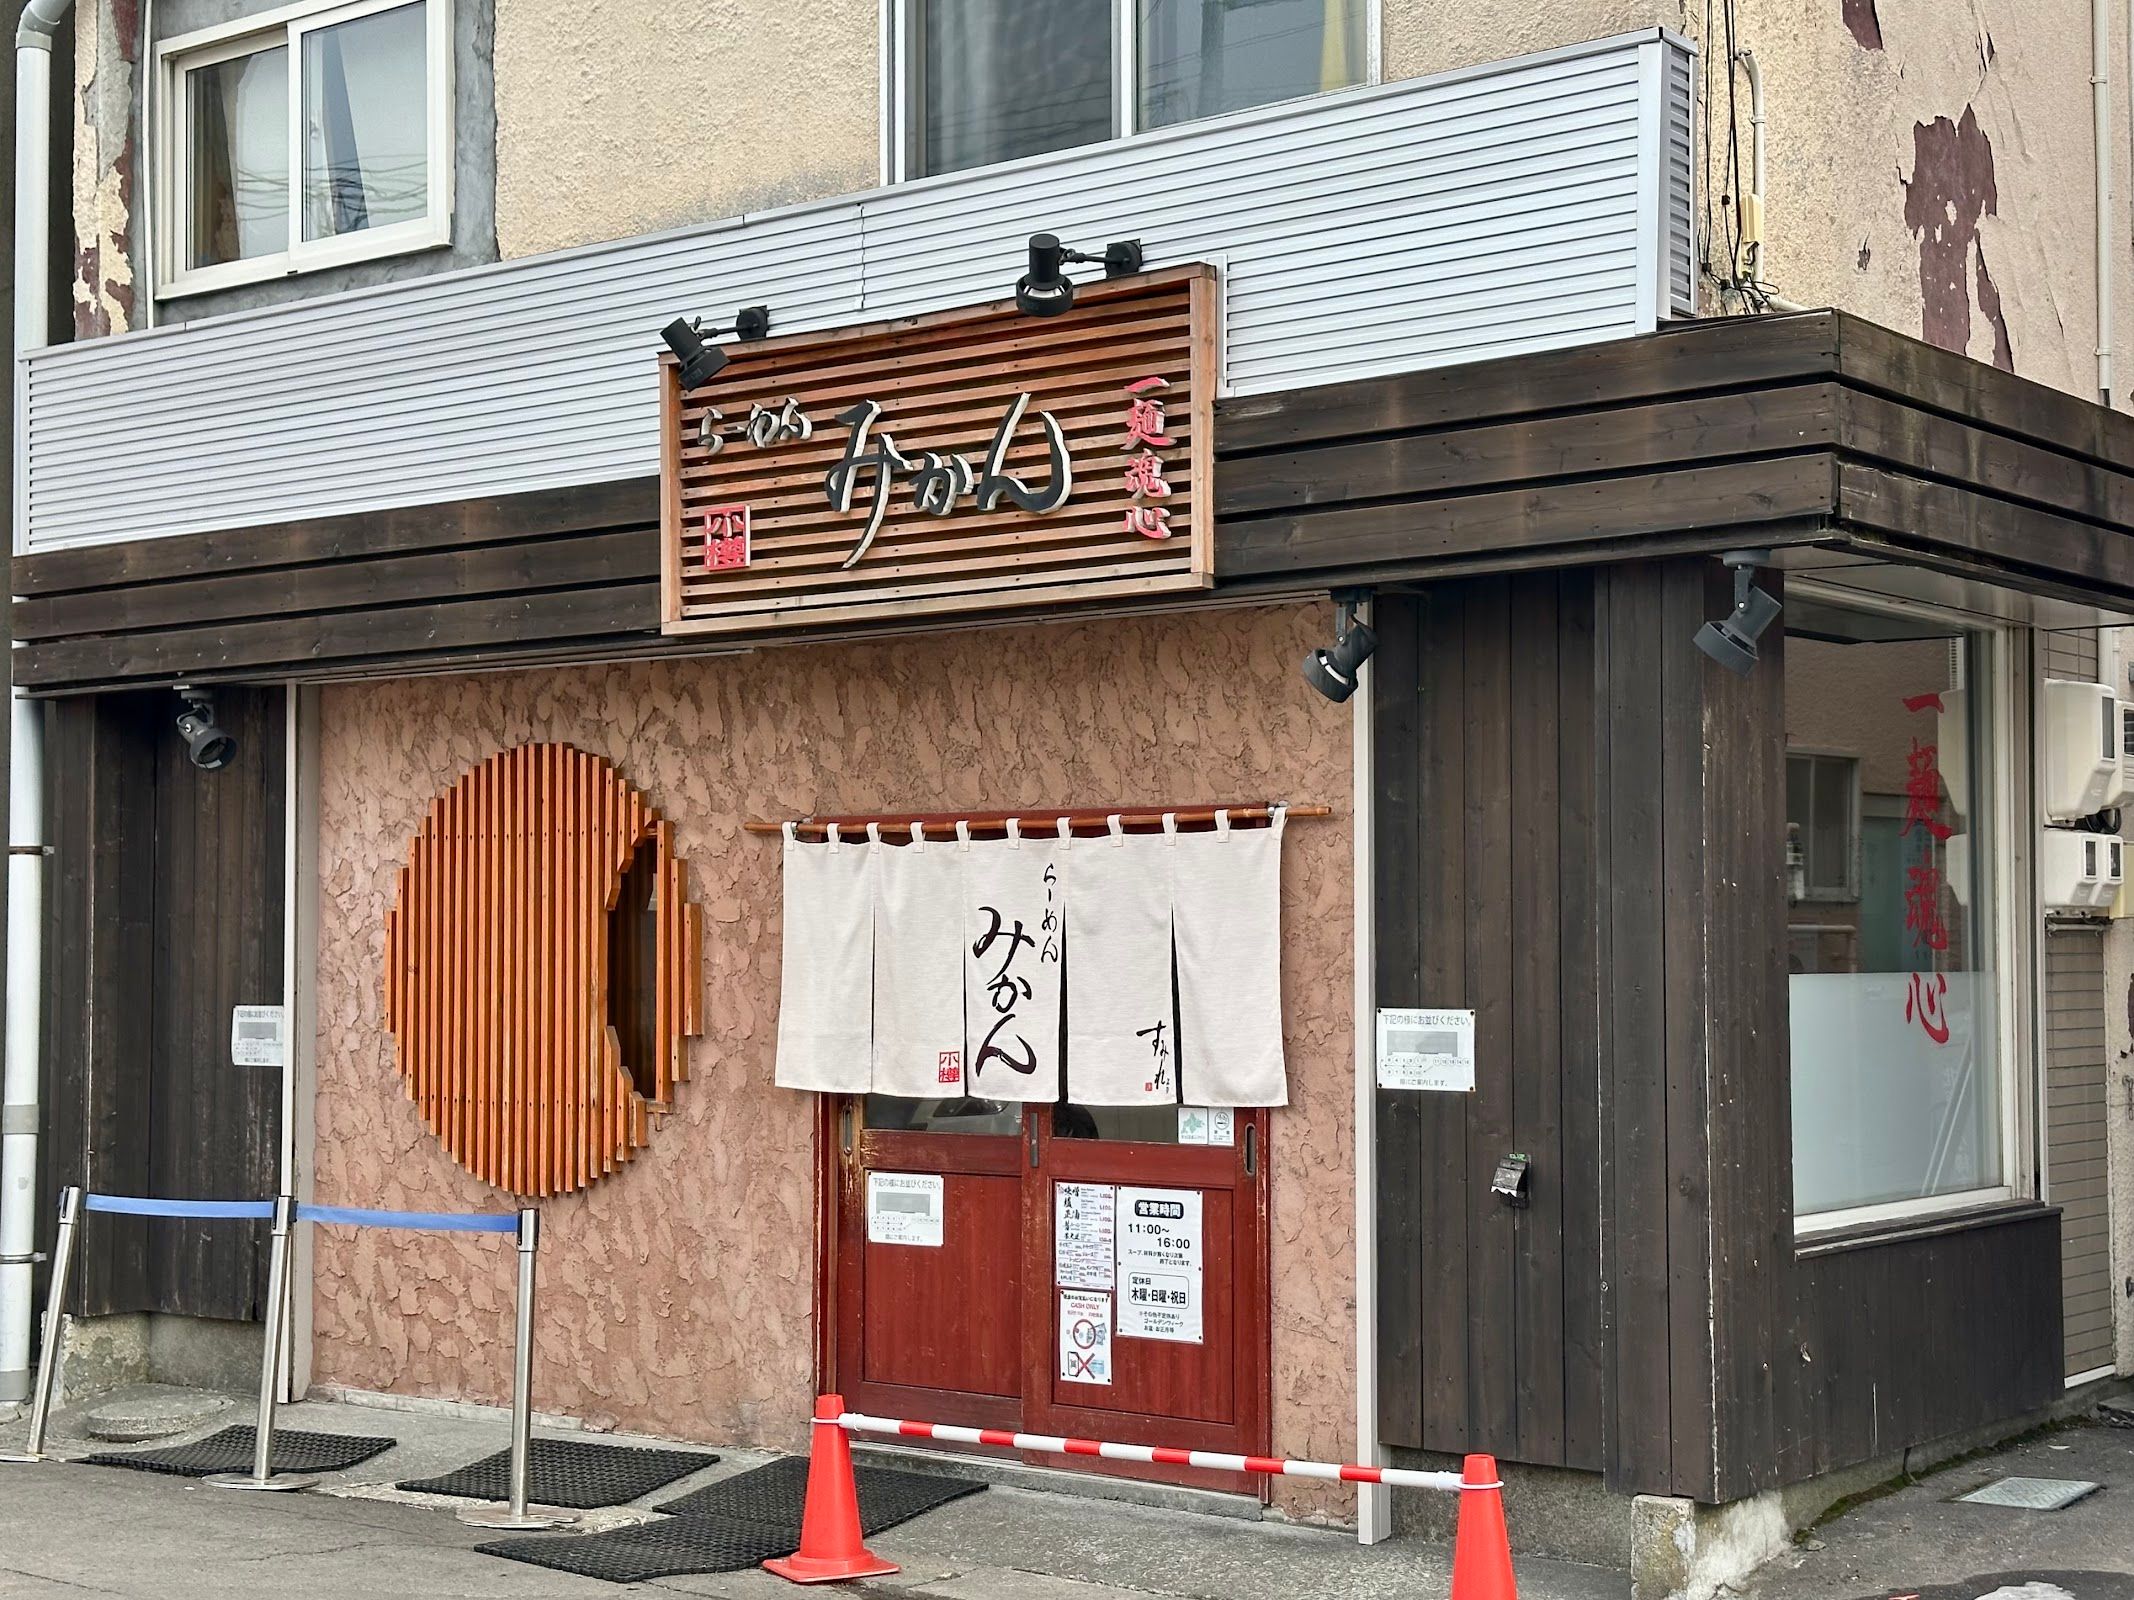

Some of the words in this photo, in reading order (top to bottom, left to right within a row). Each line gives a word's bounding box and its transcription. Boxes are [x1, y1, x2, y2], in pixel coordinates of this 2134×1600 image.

[697, 396, 813, 456] らーめん
[825, 392, 1072, 569] みかん
[1041, 863, 1058, 964] らーめん
[973, 906, 1037, 1077] みかん
[1136, 1020, 1169, 1090] すみれ
[1138, 1202, 1181, 1217] 営業時間
[1157, 1237, 1190, 1249] 16:00
[1131, 1287, 1186, 1304] 木曜・日曜・祝日
[1132, 1276, 1151, 1285] 定休日
[1144, 1318, 1184, 1327] ゴールデンウィーク
